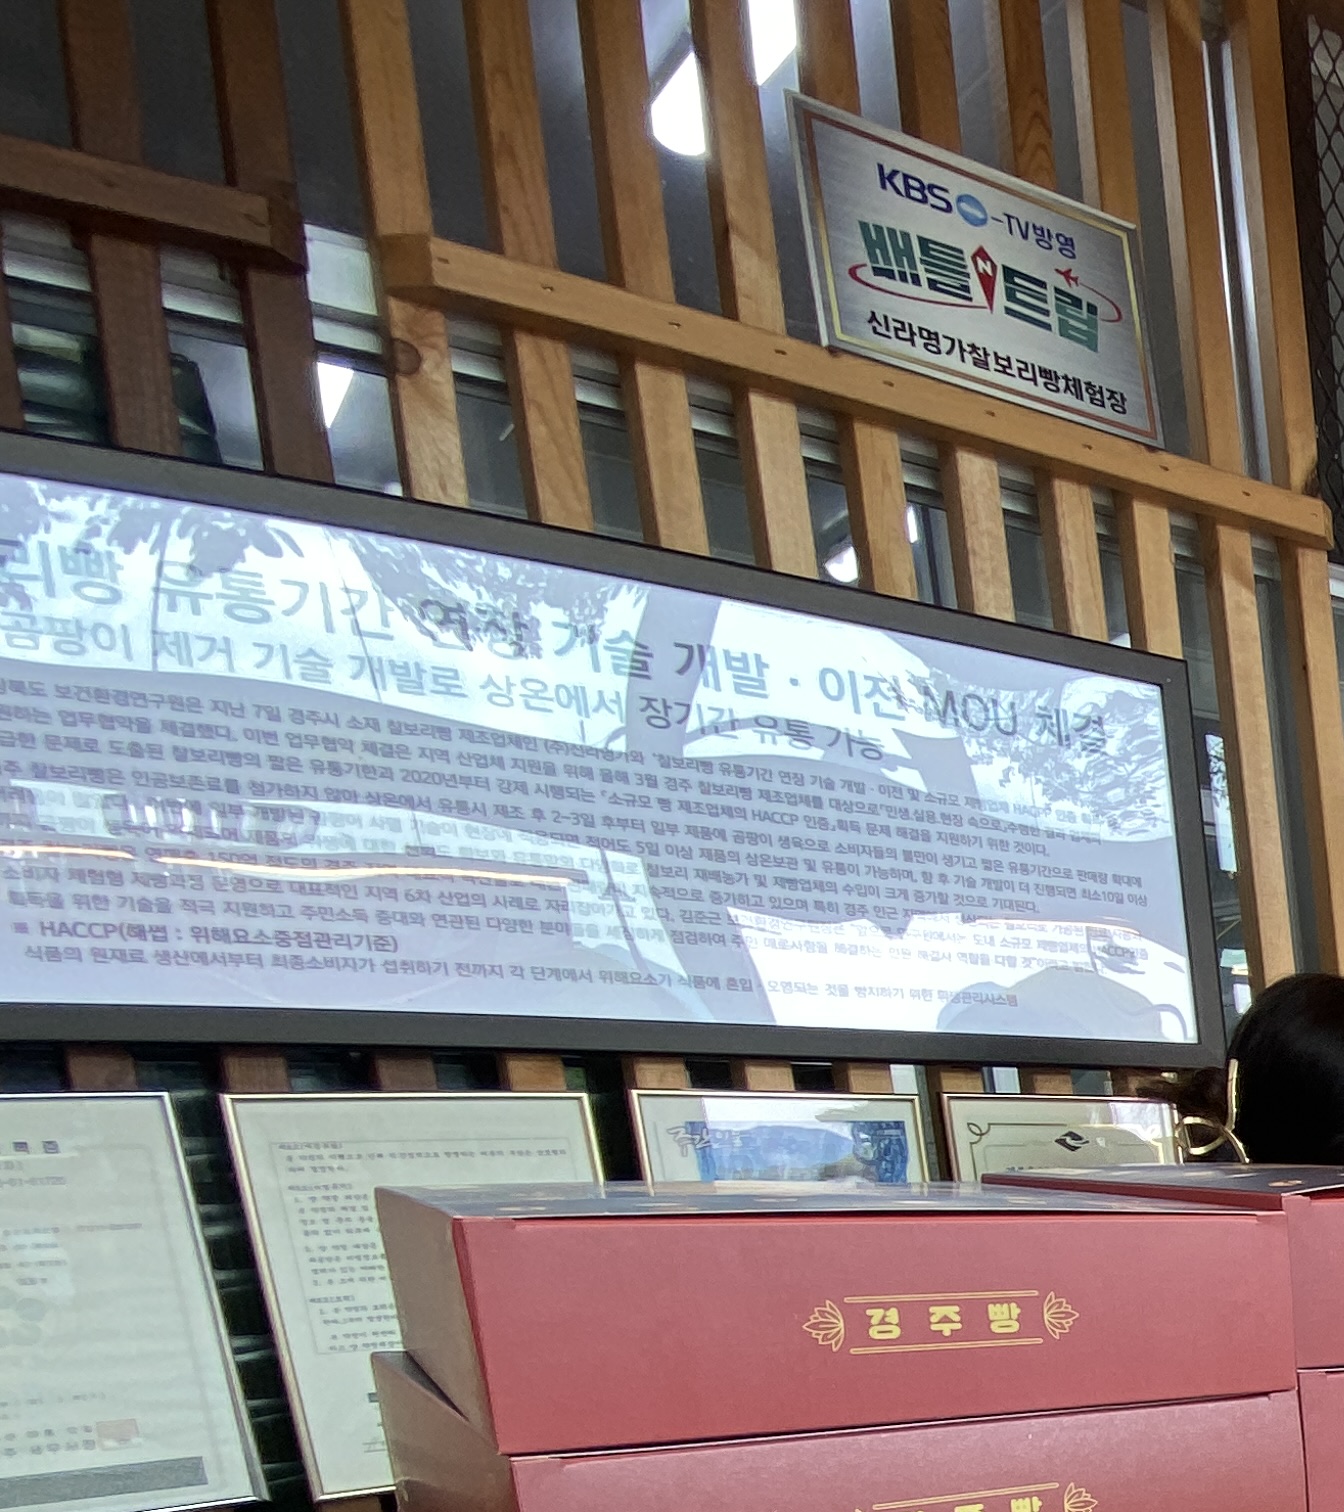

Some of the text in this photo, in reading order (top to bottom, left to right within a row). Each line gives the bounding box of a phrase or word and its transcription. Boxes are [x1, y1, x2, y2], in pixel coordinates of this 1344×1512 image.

[877, 162, 953, 214] KBS
[154, 560, 394, 641] 유통기간
[552, 620, 655, 681] 기술
[673, 642, 770, 699] 개발
[819, 666, 906, 722] 이전
[923, 688, 1018, 737] MOU
[0, 611, 887, 762] 곰팡이 제거 기술 개발로 상온에서 장기간 유통 가능
[209, 698, 247, 720] 지난
[252, 703, 282, 723] 7일
[287, 706, 341, 729] 경주시
[346, 713, 382, 733] 소재
[809, 774, 837, 792] 기술
[839, 777, 868, 797] 개발
[243, 727, 279, 746] 이번
[418, 744, 451, 766] 지역
[663, 775, 694, 793] 경주
[400, 767, 492, 793] 2020년부터
[751, 808, 800, 828] HACCP
[867, 1297, 1020, 1344] 경주빵
